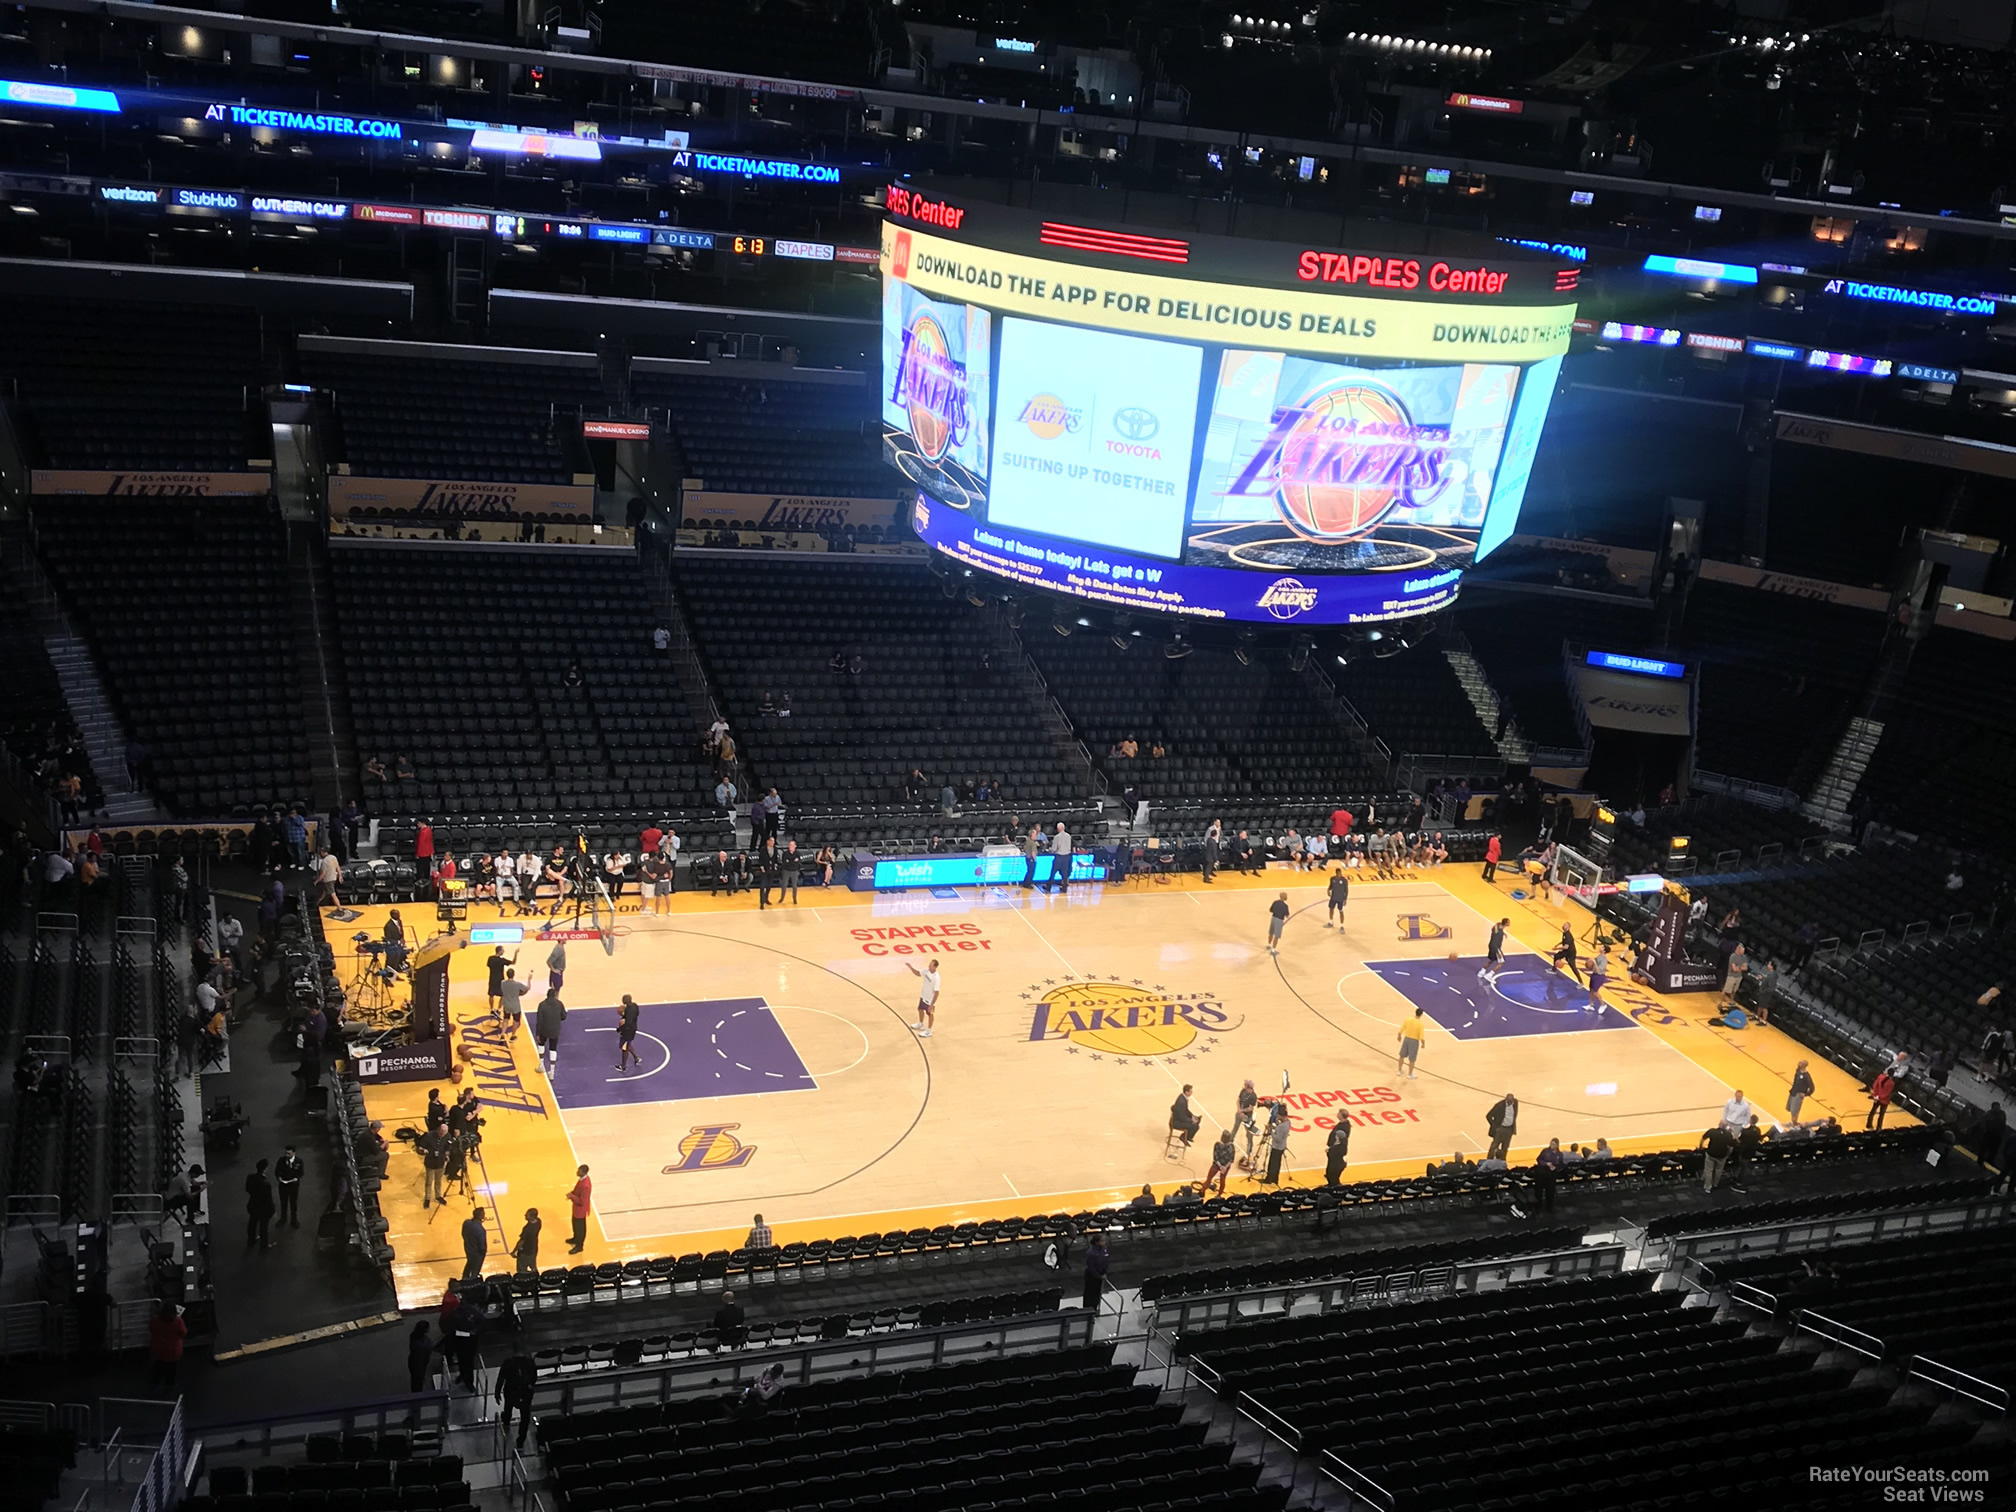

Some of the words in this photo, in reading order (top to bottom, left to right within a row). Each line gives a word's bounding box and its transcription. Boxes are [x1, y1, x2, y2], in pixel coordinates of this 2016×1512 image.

[996, 38, 1034, 52] verizon
[808, 87, 837, 99] 69050
[1470, 98, 1510, 109] McDonald's
[204, 104, 226, 120] AT
[231, 106, 401, 139] TICKETMASTER.COM
[673, 152, 691, 167] AT
[695, 154, 839, 182] TICKETMASTER.COM
[101, 187, 157, 202] verizon
[179, 191, 237, 208] StubHub
[376, 210, 412, 220] McDonald's
[912, 192, 964, 229] Center
[425, 211, 487, 229] TOSHIBA
[496, 216, 515, 226] DEN
[598, 229, 615, 239] BUD
[616, 230, 641, 240] LIGHT
[669, 234, 712, 246] DELTA
[734, 236, 764, 254] 6:13
[776, 241, 831, 259] STAPLES
[1298, 250, 1421, 290] STAPLES
[1429, 262, 1508, 293] Center
[916, 253, 1003, 290] DOWNLOAD
[1008, 274, 1046, 298] THE
[1051, 283, 1097, 305] APP
[1104, 291, 1151, 314] FOR
[1158, 298, 1293, 331] DELICIOUS
[1299, 313, 1377, 338] DEALS
[1825, 279, 1845, 294] AT
[1847, 281, 1995, 315] TICKETMASTER.COM
[1433, 323, 1529, 344] DOWNLOAD
[1533, 327, 1550, 342] THE
[1689, 334, 1743, 351] TOSHIBA
[916, 339, 931, 357] LOS
[1755, 344, 1771, 354] BUD
[1772, 347, 1795, 358] LIGHT
[1913, 368, 1957, 382] DELTA
[888, 326, 970, 448] LAKERS
[1013, 400, 1084, 433] LAKERS
[1316, 415, 1358, 433] LOS
[1358, 422, 1452, 443] ANGELES
[1106, 440, 1161, 461] TOYOTA
[1212, 405, 1454, 509] LAKERS
[160, 475, 210, 483] ANGELES
[1002, 452, 1063, 475] SUITING
[1068, 464, 1088, 479] UP
[1093, 468, 1175, 496] TOGETHER
[416, 483, 517, 513] LAKERS
[467, 485, 517, 493] ANGELES
[759, 498, 849, 526] LAKERS
[806, 499, 851, 507] ANGELES
[974, 528, 1003, 548] Lakers
[1005, 540, 1015, 552] at
[1016, 541, 1044, 560] home
[1046, 549, 1081, 570] today!
[1084, 557, 1110, 574] Lets
[1112, 565, 1133, 579] get
[1135, 569, 1144, 580] a
[1147, 569, 1162, 582] W
[1010, 560, 1017, 568] to
[1093, 579, 1112, 591] Data
[1113, 583, 1136, 594] Rates
[1018, 573, 1035, 583] your
[1076, 587, 1086, 596] No
[1088, 591, 1125, 604] purchase
[1126, 597, 1167, 611] necessary
[1179, 606, 1225, 617] participate
[1256, 586, 1318, 611] LAKERS
[1607, 655, 1631, 667] BUD
[1632, 659, 1665, 672] LIGHT
[1588, 696, 1679, 717] LAKERS
[850, 923, 982, 940] STAPLES
[862, 939, 991, 957] Center
[1070, 999, 1108, 1007] LOS
[1114, 992, 1216, 1005] ANGELES
[1018, 1001, 1245, 1042] LAKERS
[380, 1056, 436, 1067] PECHANGA
[457, 1012, 548, 1121] LAKERS
